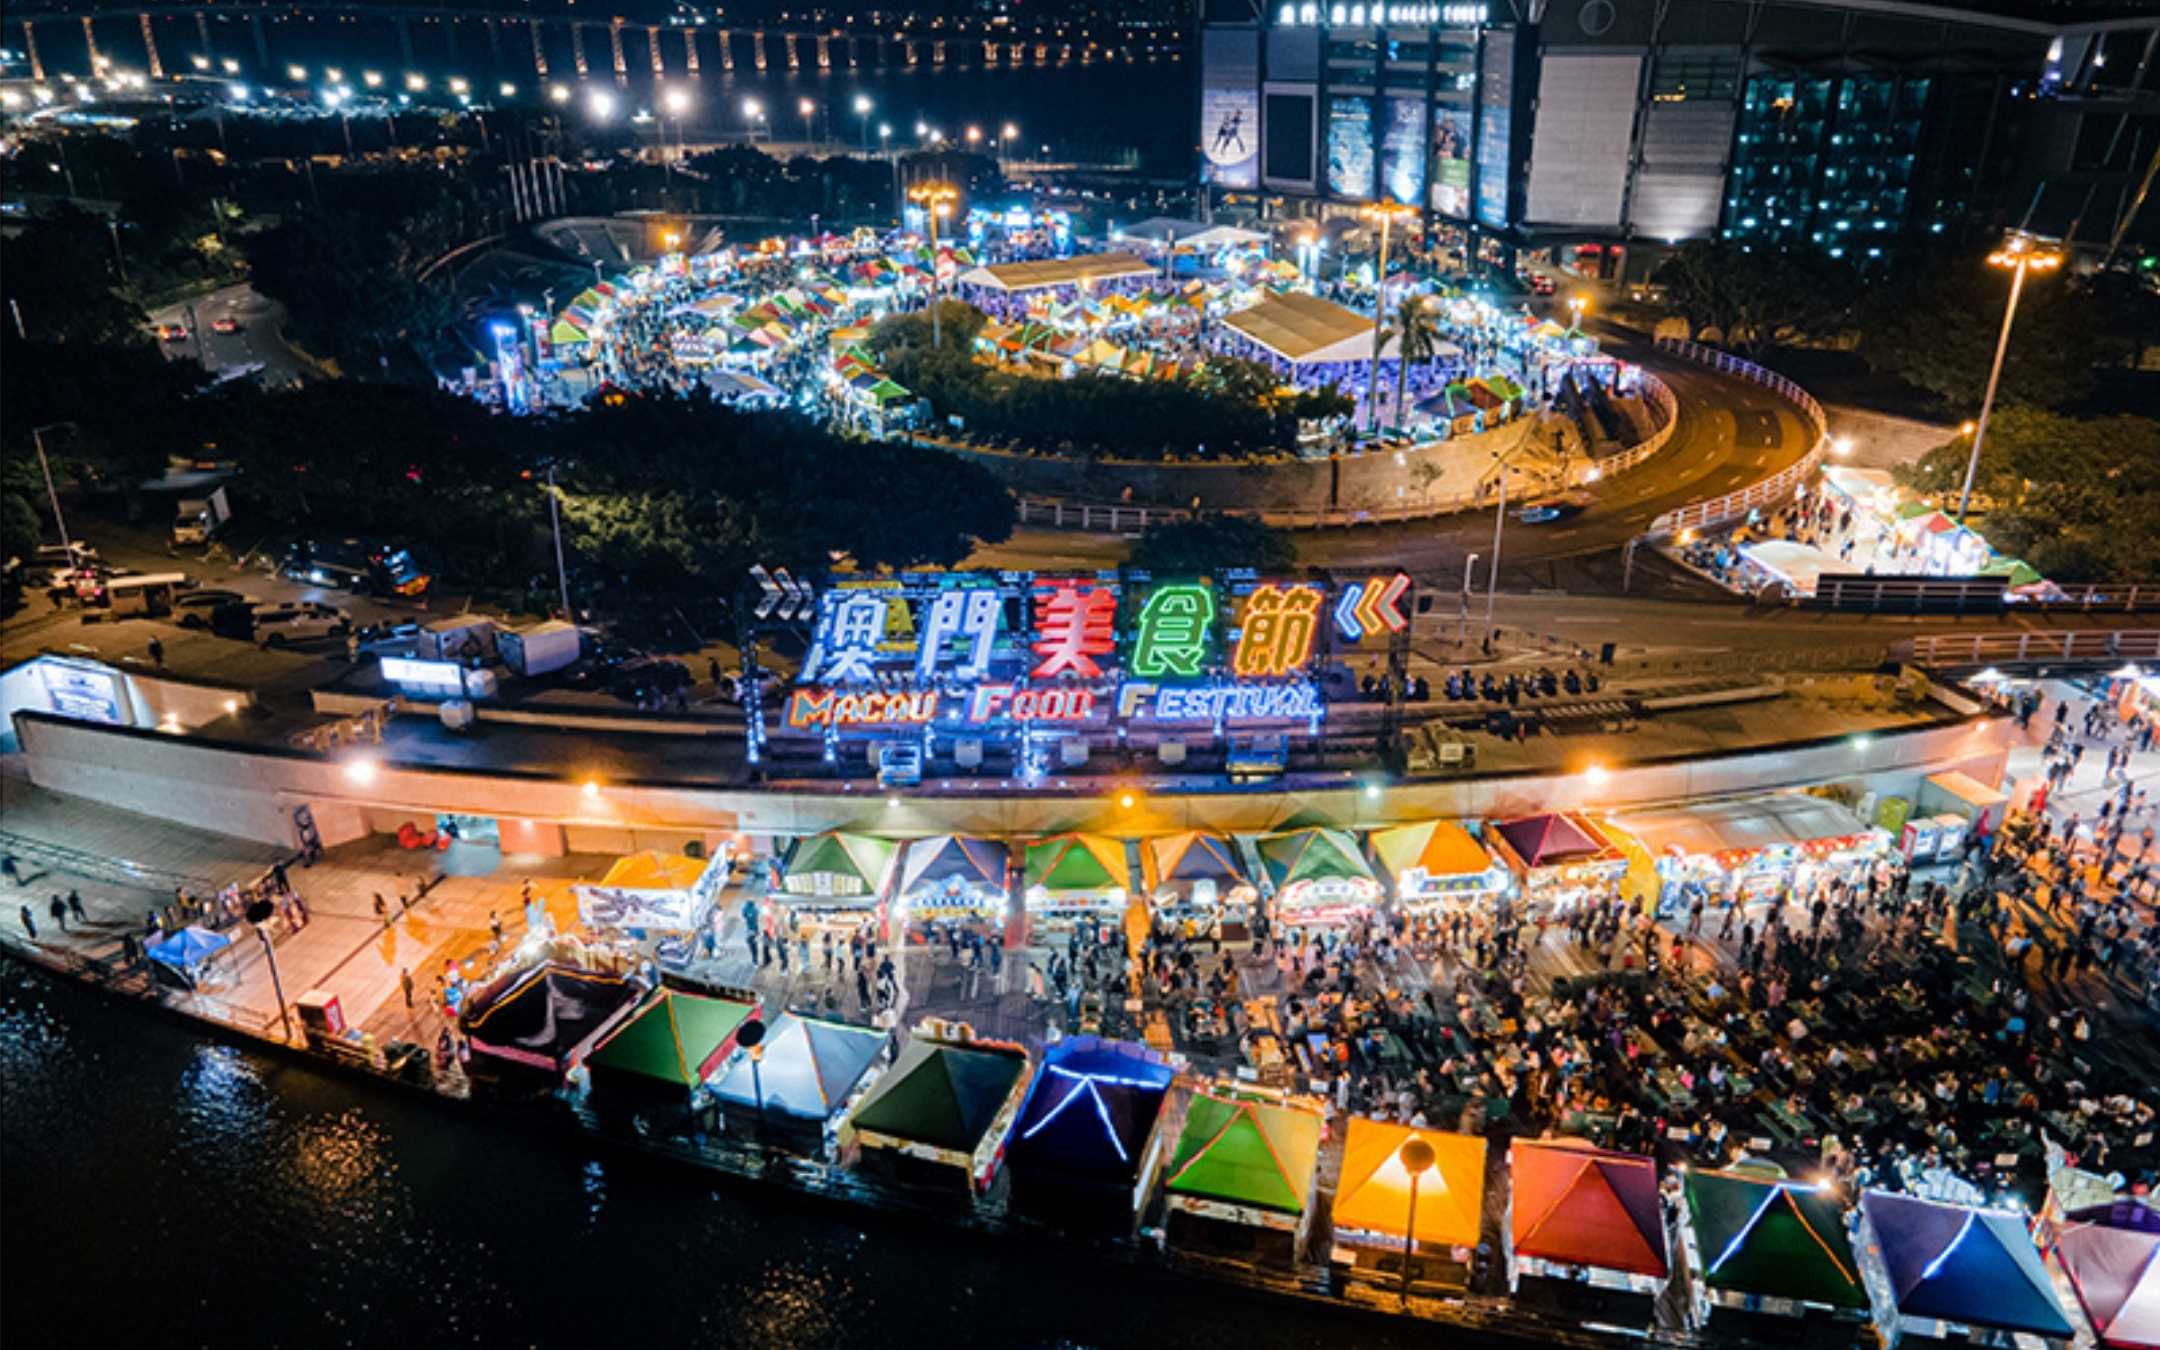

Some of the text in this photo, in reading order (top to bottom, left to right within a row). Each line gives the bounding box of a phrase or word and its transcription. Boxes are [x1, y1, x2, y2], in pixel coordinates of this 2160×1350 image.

[799, 578, 1324, 682] 澳門美食節
[788, 683, 1322, 727] MACAU FOOD FESTIVAL
